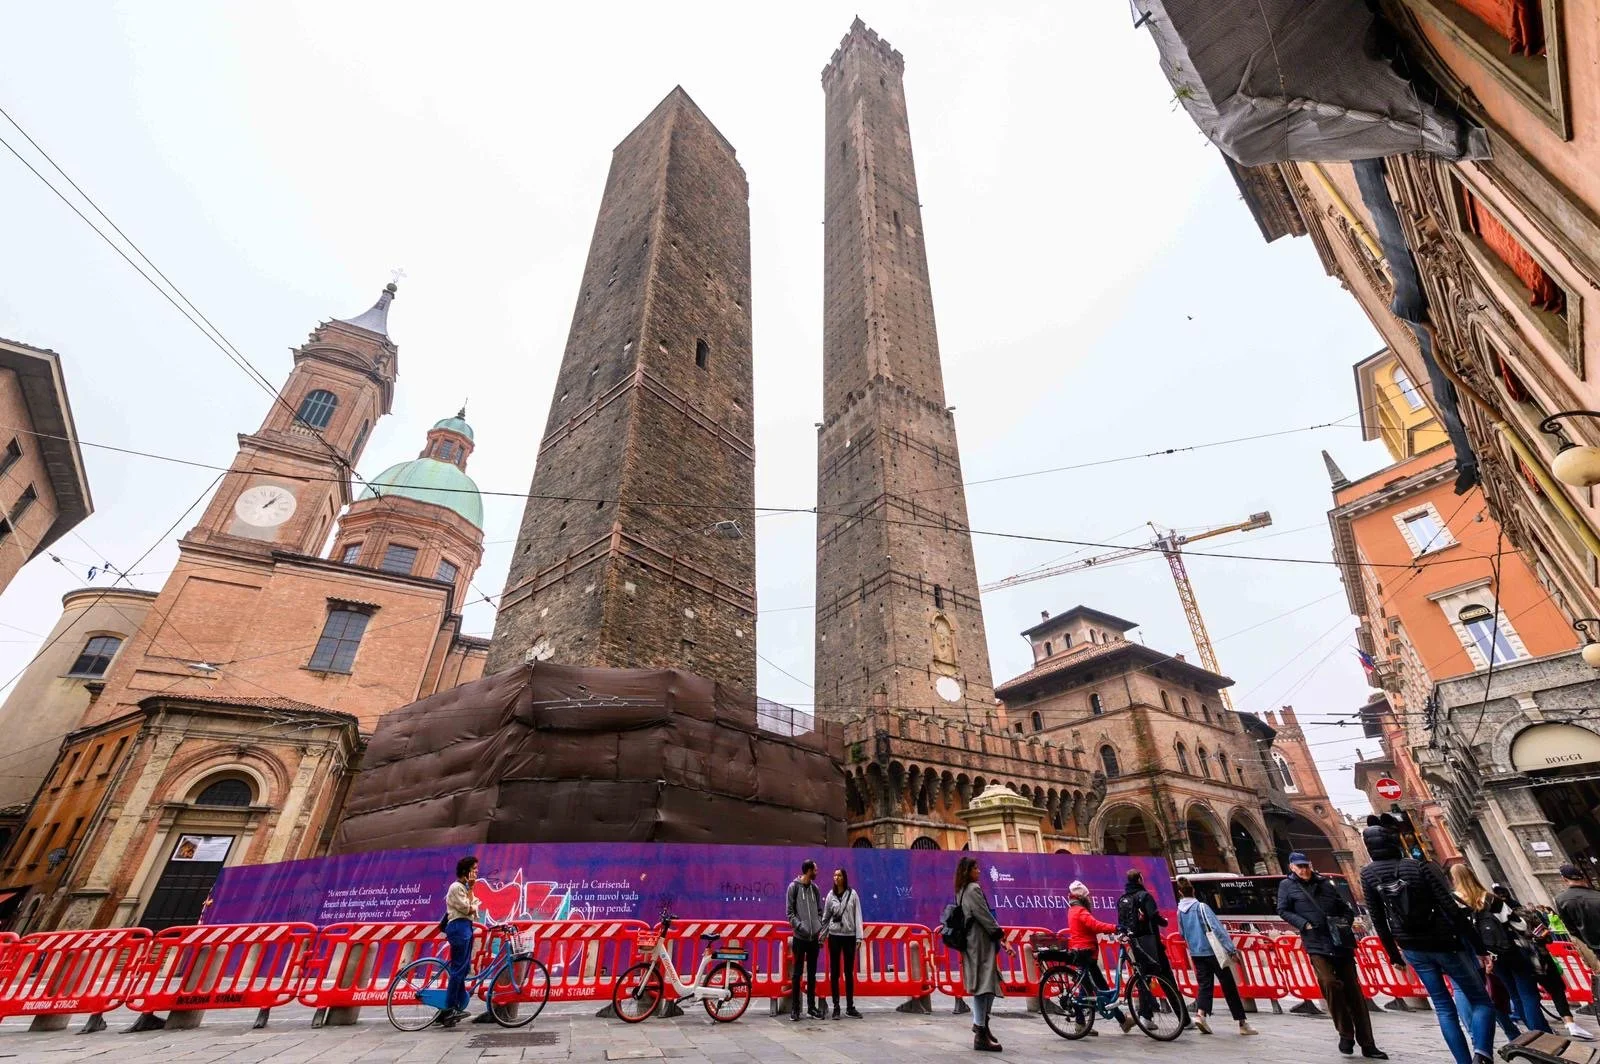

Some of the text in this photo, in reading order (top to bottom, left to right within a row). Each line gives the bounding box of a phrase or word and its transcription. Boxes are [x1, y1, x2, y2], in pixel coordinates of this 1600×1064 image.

[1545, 753, 1583, 764] BOGGI
[581, 880, 589, 889] la
[590, 879, 630, 889] Carisenda
[1220, 880, 1254, 888] www.tper.it
[358, 885, 388, 895] Carisenda,
[399, 884, 421, 894] behold
[597, 891, 619, 901] nuvol
[621, 891, 639, 901] vada
[380, 896, 397, 906] when
[395, 898, 410, 908] goes
[414, 895, 432, 905] cloud
[993, 895, 1116, 909] LA GARISEN E LE
[357, 909, 385, 920] opposite
[352, 991, 388, 1001] BOLOGNA
[567, 987, 596, 997] STRADE
